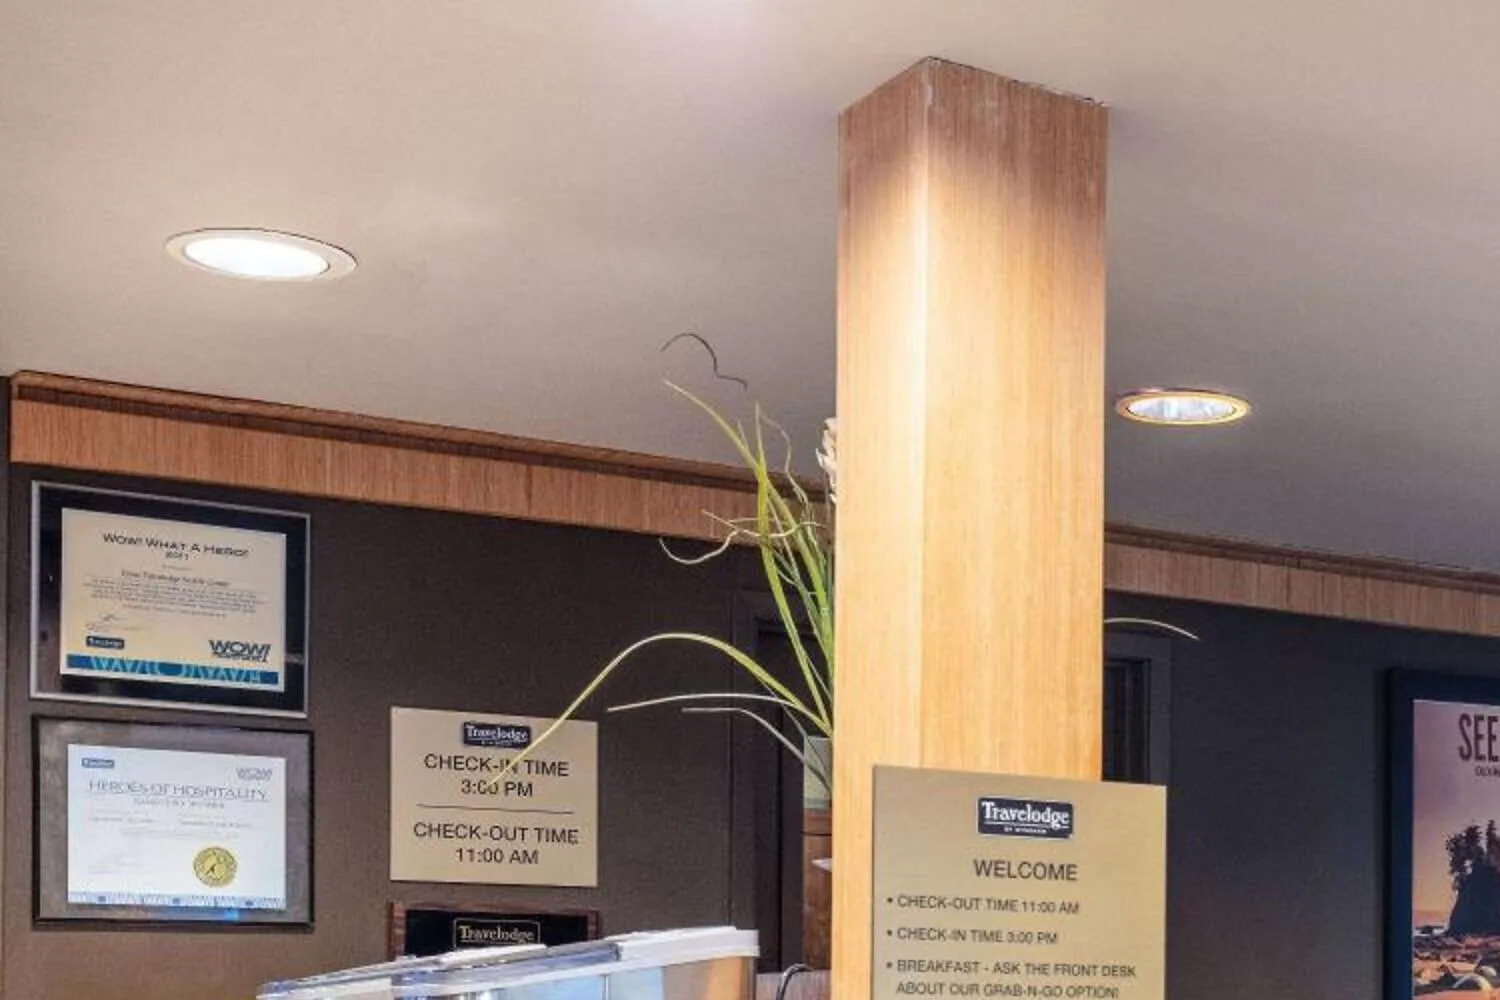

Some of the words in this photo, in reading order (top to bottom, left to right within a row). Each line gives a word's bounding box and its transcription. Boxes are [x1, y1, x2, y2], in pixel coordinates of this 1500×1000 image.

[146, 538, 185, 551] WHAT
[192, 543, 200, 552] A
[465, 724, 528, 742] Travelodge
[1458, 713, 1499, 762] SEE
[424, 754, 517, 774] CHECK-IN
[524, 759, 569, 777] TIME
[461, 779, 499, 795] 3:00
[504, 782, 533, 797] PM
[981, 801, 1069, 830] Travelodge
[413, 822, 529, 842] CHECK-OUT
[535, 827, 579, 844] TIME
[456, 848, 504, 863] 11:00
[509, 849, 538, 864] AM
[974, 858, 1079, 881] WELCOME
[897, 894, 983, 911] CHECK-OUT
[985, 898, 1018, 912] TIME
[1022, 900, 1055, 913] 11:00
[1059, 901, 1079, 914] AM
[459, 925, 534, 944] Travelodge
[897, 927, 966, 942] CHECK-IN
[970, 929, 1003, 942] TIME
[1007, 930, 1033, 944] 3:00
[1037, 932, 1058, 944] PM
[897, 960, 980, 974] BREAKFAST
[993, 962, 1020, 975] ASK
[1026, 963, 1049, 976] THE
[1054, 964, 1098, 976] FRONT
[1102, 965, 1136, 977] DESK
[896, 982, 944, 996] ABOUT
[950, 982, 979, 996] OUR
[984, 983, 1062, 998] GRAB-N-GO
[1068, 985, 1119, 998] OPTION!
